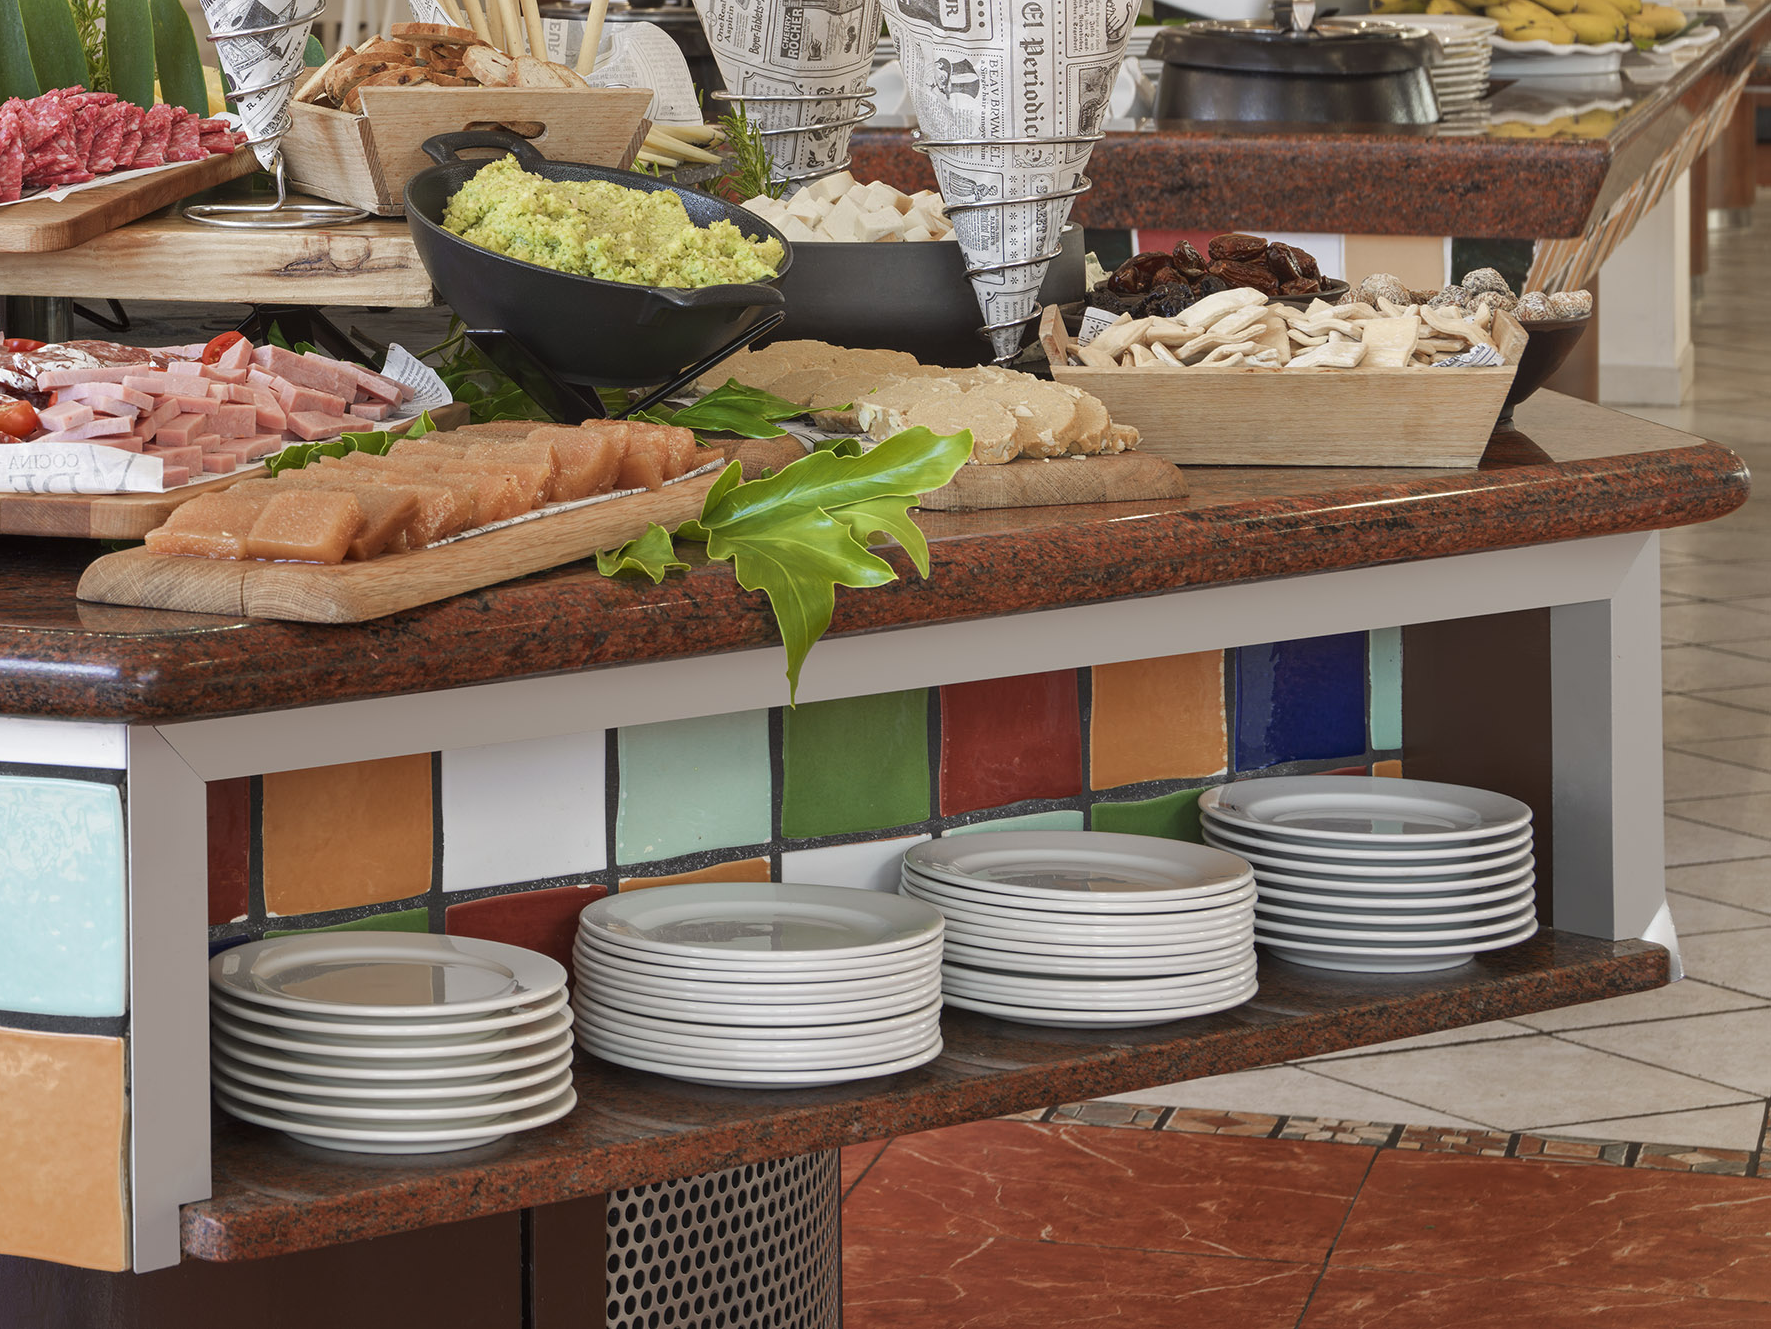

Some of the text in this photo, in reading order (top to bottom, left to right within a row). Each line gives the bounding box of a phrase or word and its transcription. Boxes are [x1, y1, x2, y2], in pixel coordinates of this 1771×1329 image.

[716, 22, 724, 42] One
[724, 5, 734, 43] Aspirin
[748, 6, 763, 55] Bayer-Tablets
[782, 12, 792, 49] CHERRY-
[788, 8, 803, 58] ROCHER
[1019, 3, 1045, 140] El Periodic
